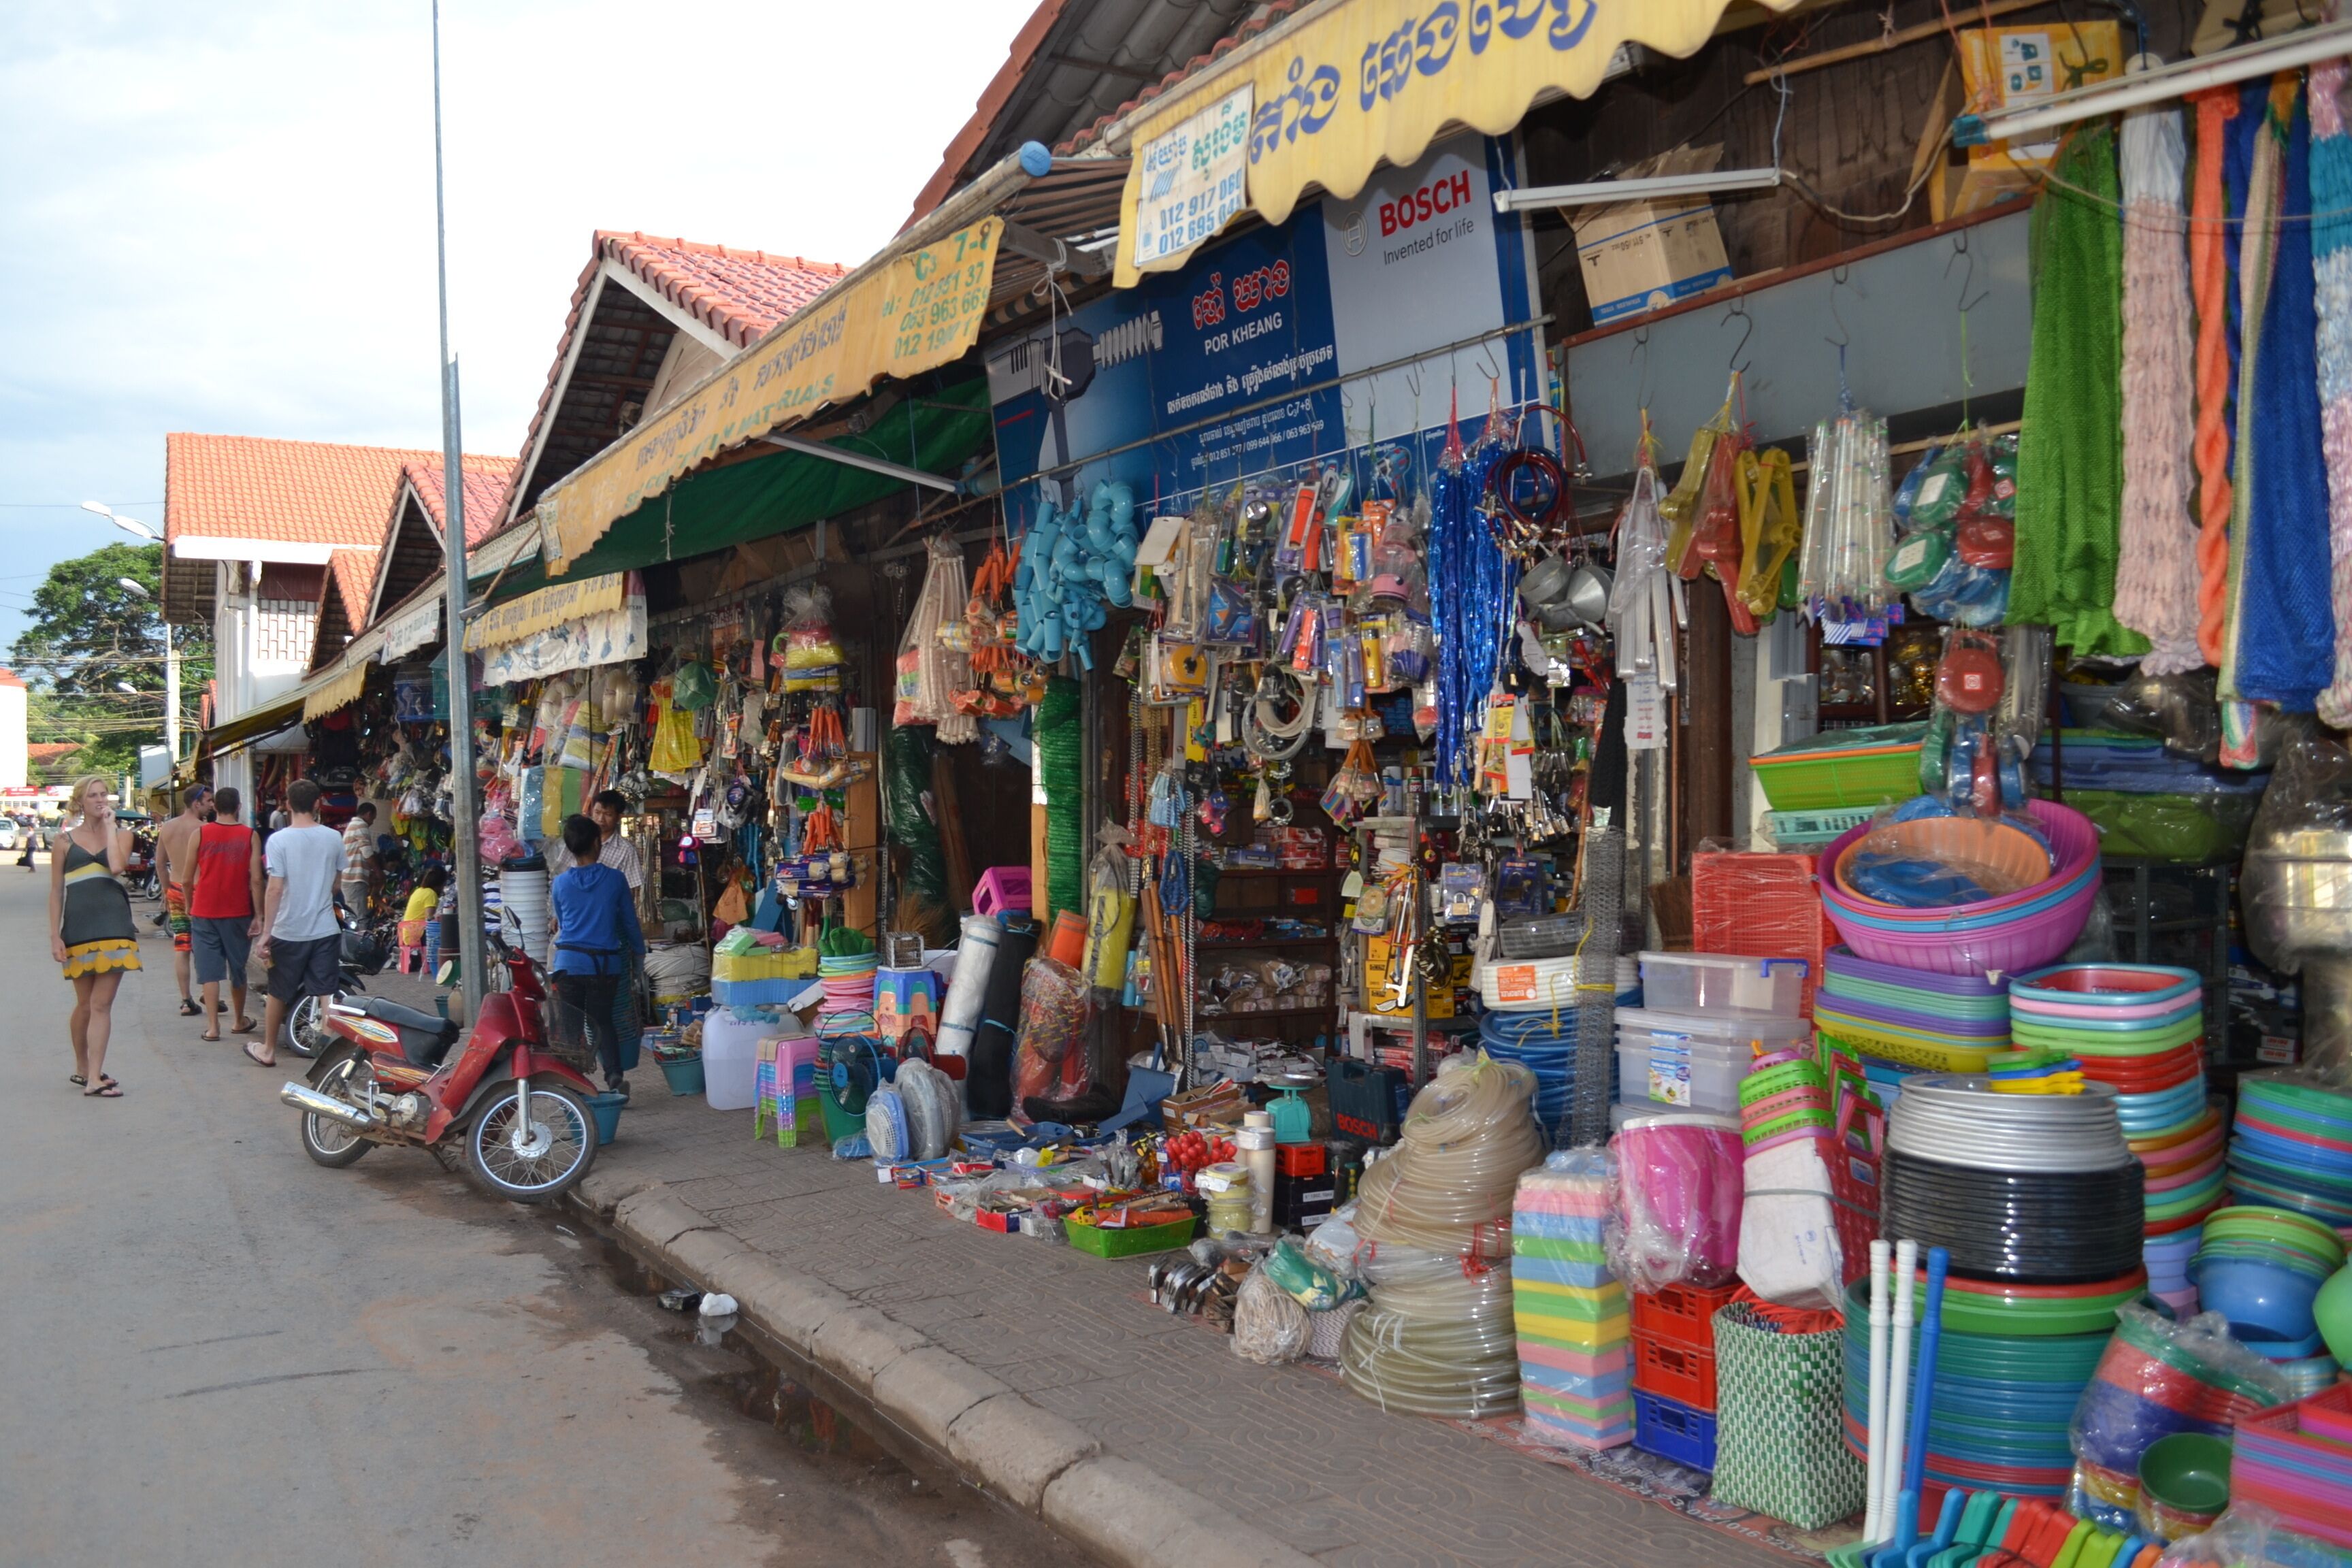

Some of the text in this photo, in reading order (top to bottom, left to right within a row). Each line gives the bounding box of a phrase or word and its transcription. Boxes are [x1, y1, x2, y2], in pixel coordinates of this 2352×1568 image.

[1160, 201, 1185, 230] 012
[1188, 188, 1216, 219] 917
[1379, 169, 1472, 238] BOSCH
[1159, 227, 1184, 254] 012
[1188, 210, 1214, 240] 695
[1383, 218, 1474, 266] Invented for life
[930, 297, 958, 325] 963
[894, 333, 921, 360] 012
[1205, 312, 1282, 356] POR KHEANG
[1209, 451, 1220, 463] 012
[1220, 448, 1231, 460] 851
[1246, 439, 1258, 452] 099
[1258, 435, 1270, 448] 644
[1286, 427, 1299, 440] 063
[1299, 423, 1311, 437] 963
[1336, 1113, 1379, 1141] BOSCH
